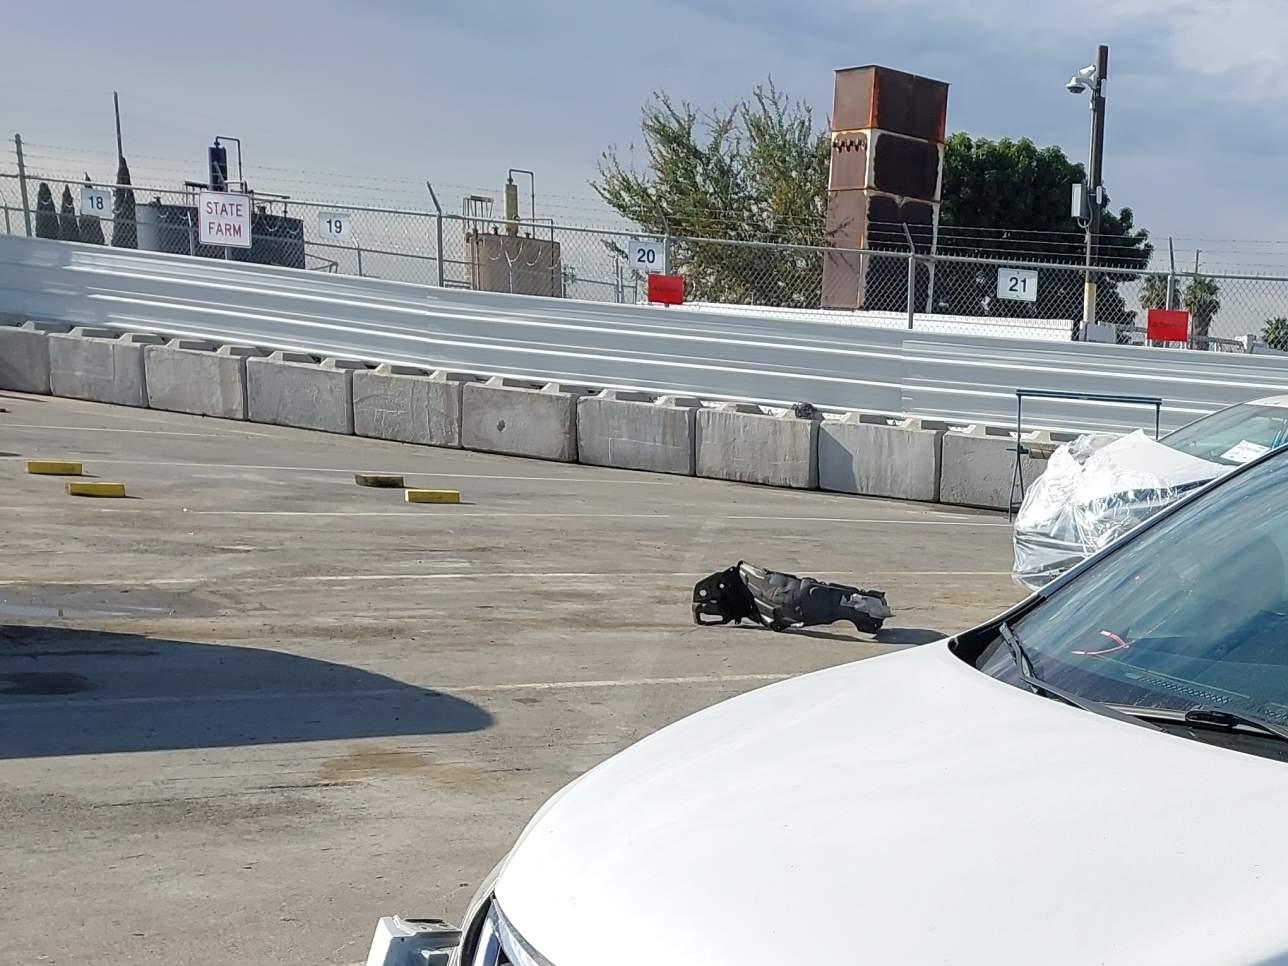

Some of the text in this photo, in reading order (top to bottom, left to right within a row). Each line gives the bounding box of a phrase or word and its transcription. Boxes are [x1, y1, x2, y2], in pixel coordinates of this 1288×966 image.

[88, 196, 104, 210] 18
[206, 201, 243, 217] STATE
[208, 222, 242, 238] FARM
[326, 219, 343, 234] 19
[637, 248, 656, 265] 20
[1009, 277, 1030, 293] 21
